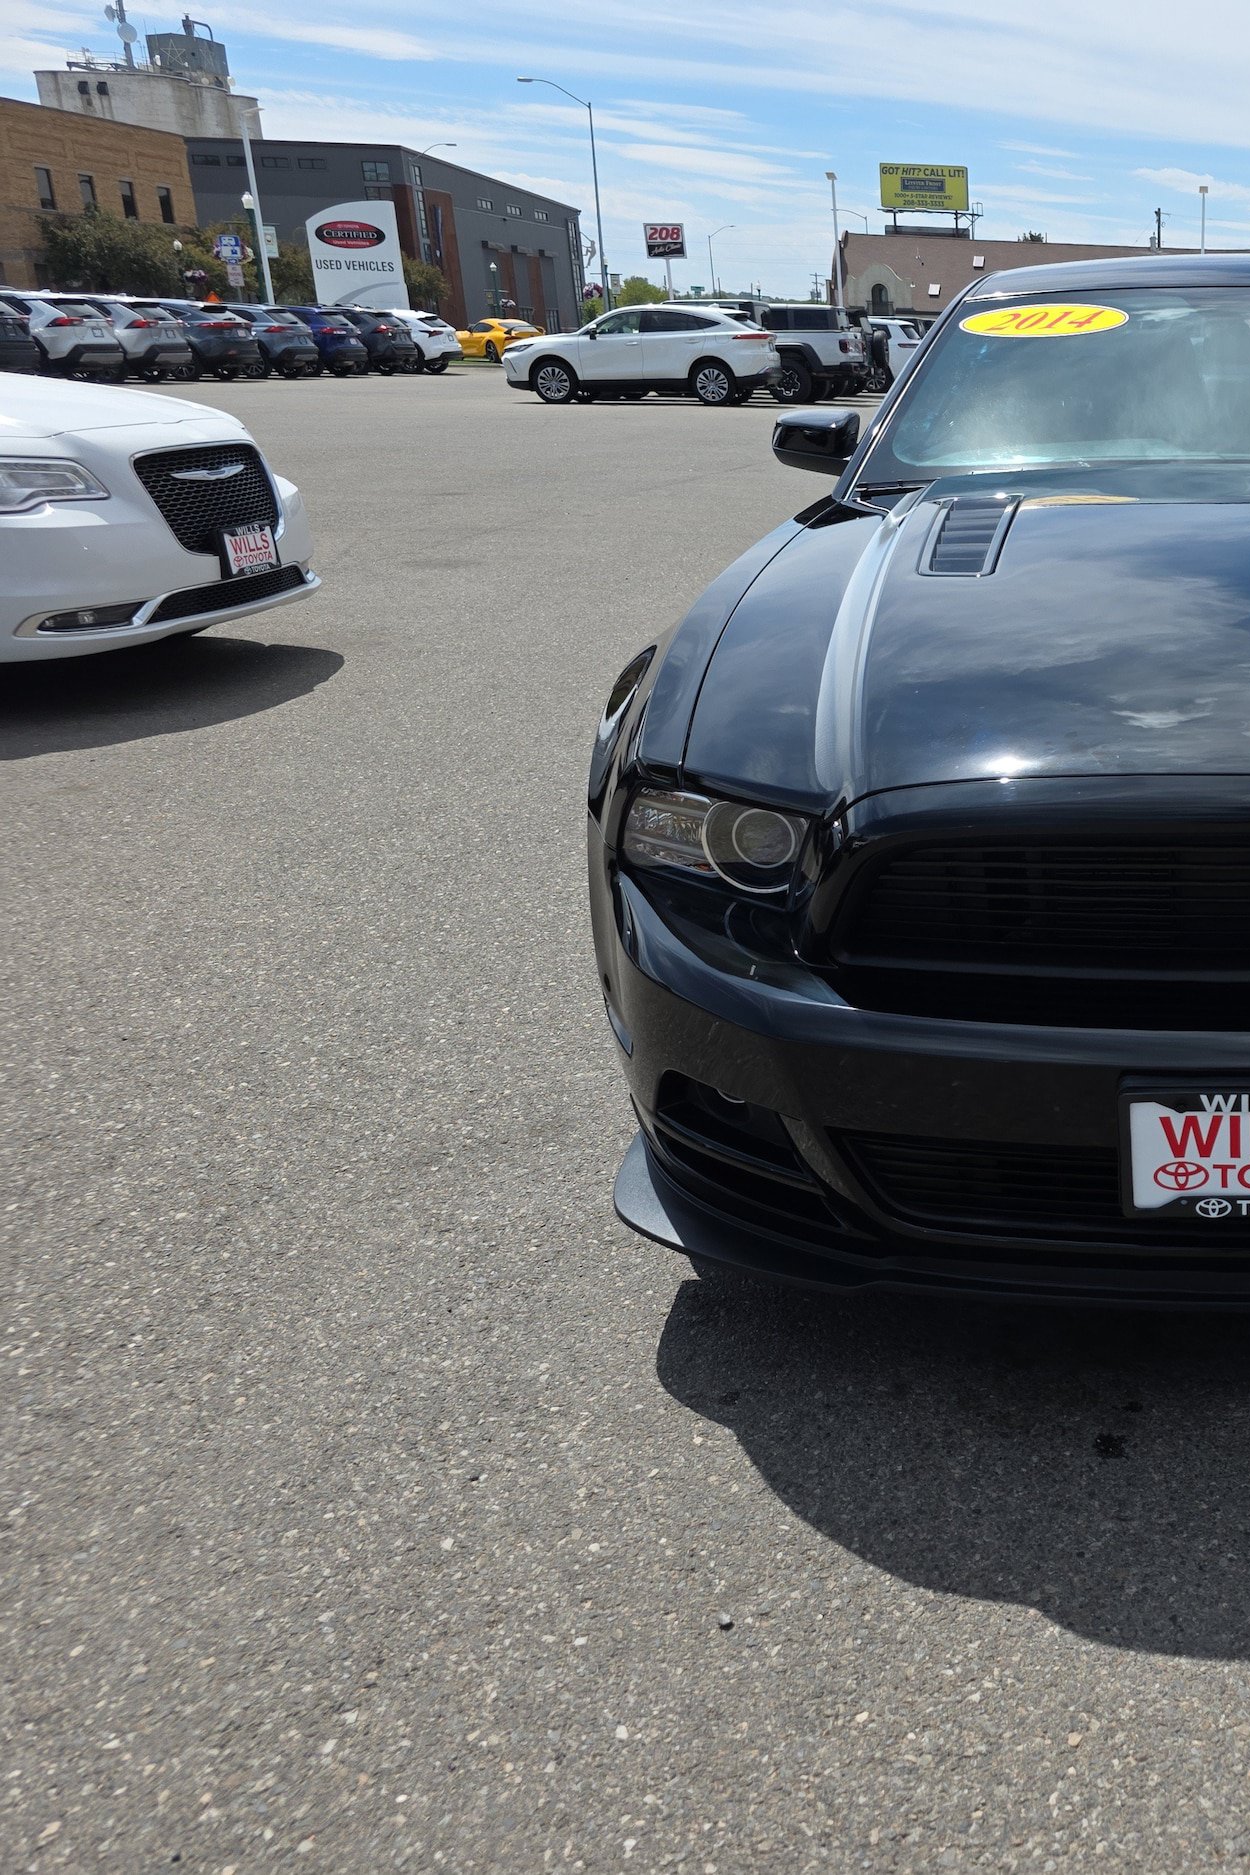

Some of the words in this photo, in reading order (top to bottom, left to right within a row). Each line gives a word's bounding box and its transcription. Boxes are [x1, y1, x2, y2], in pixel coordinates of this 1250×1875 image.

[881, 166, 900, 175] GOT
[901, 168, 922, 176] HIT?
[923, 168, 946, 177] CALL
[948, 169, 965, 178] LIT!
[323, 229, 378, 239] CERTIFIED
[648, 227, 681, 240] 208
[315, 259, 342, 270] USED
[344, 260, 395, 272] VEHICLES
[984, 310, 1105, 332] 2014
[235, 524, 260, 535] WILLS
[229, 533, 270, 554] WILLS
[243, 551, 273, 564] TOYOTA
[251, 564, 271, 573] TOYOTA
